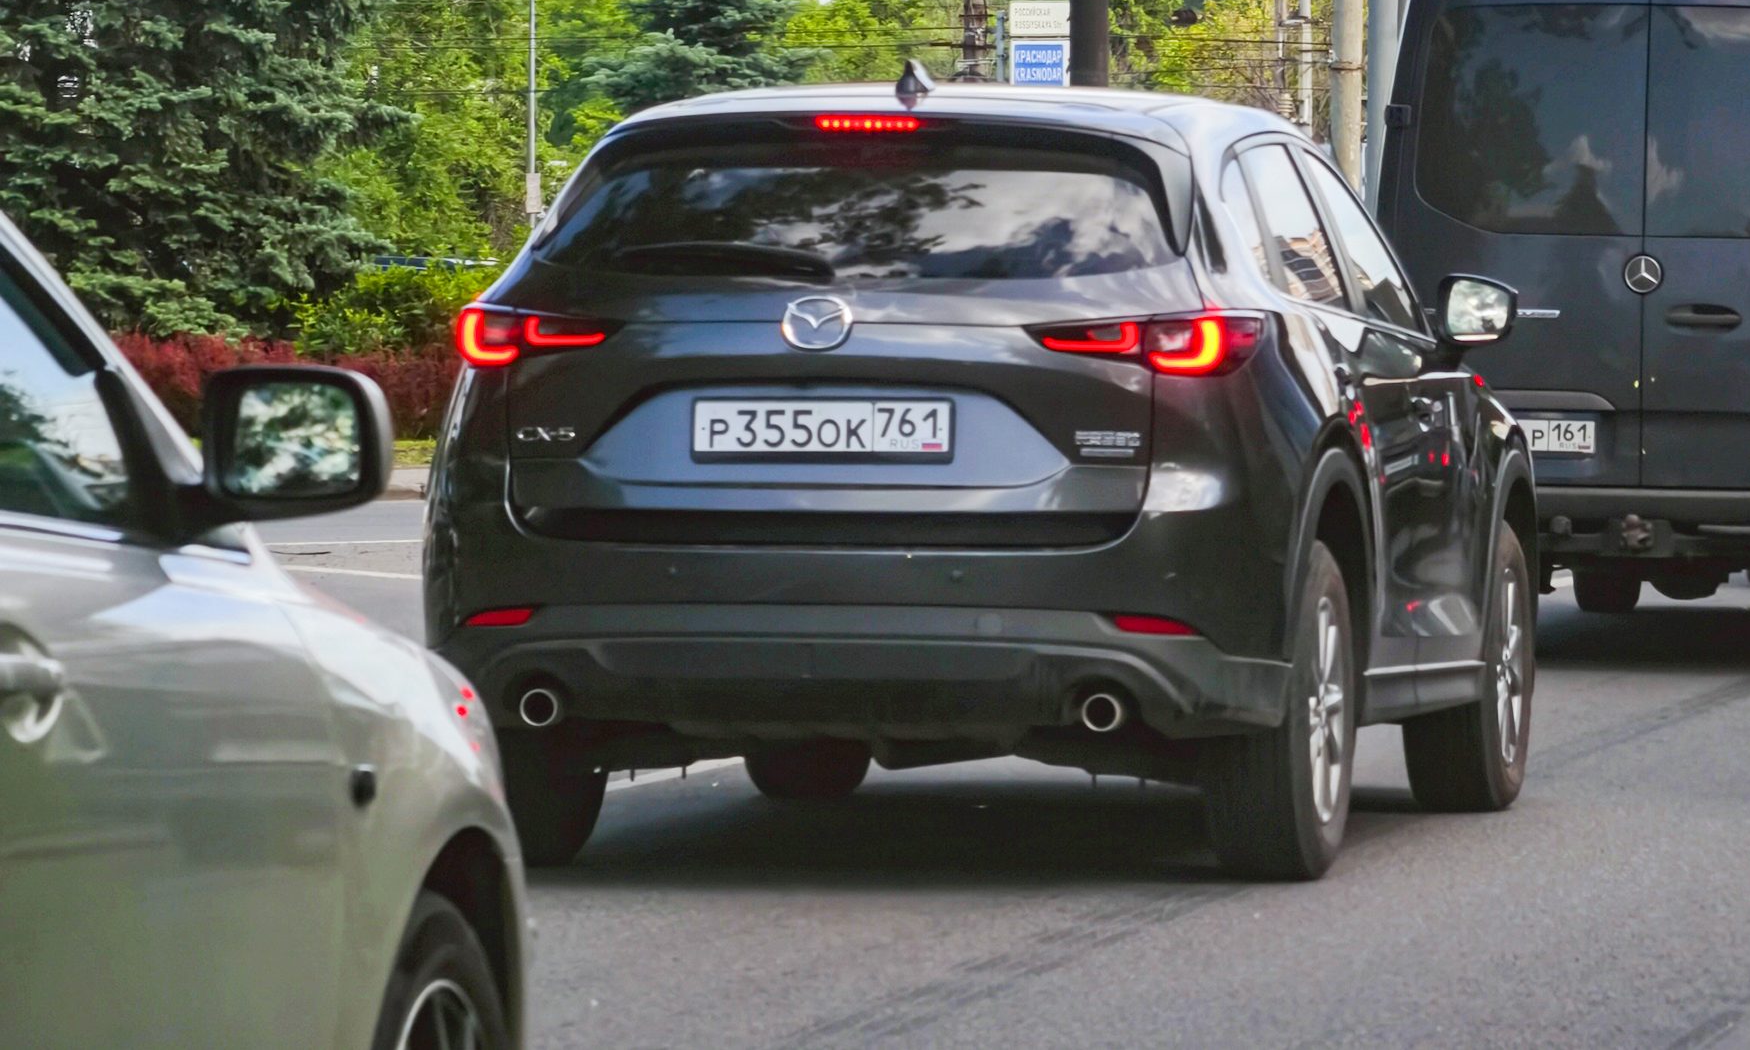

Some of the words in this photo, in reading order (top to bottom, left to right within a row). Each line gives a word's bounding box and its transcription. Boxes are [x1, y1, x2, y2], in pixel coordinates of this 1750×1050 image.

[1015, 50, 1062, 65] КРАСНОДАР
[877, 408, 938, 439] 761
[1552, 424, 1587, 442] 161
[890, 439, 919, 449] RUS
